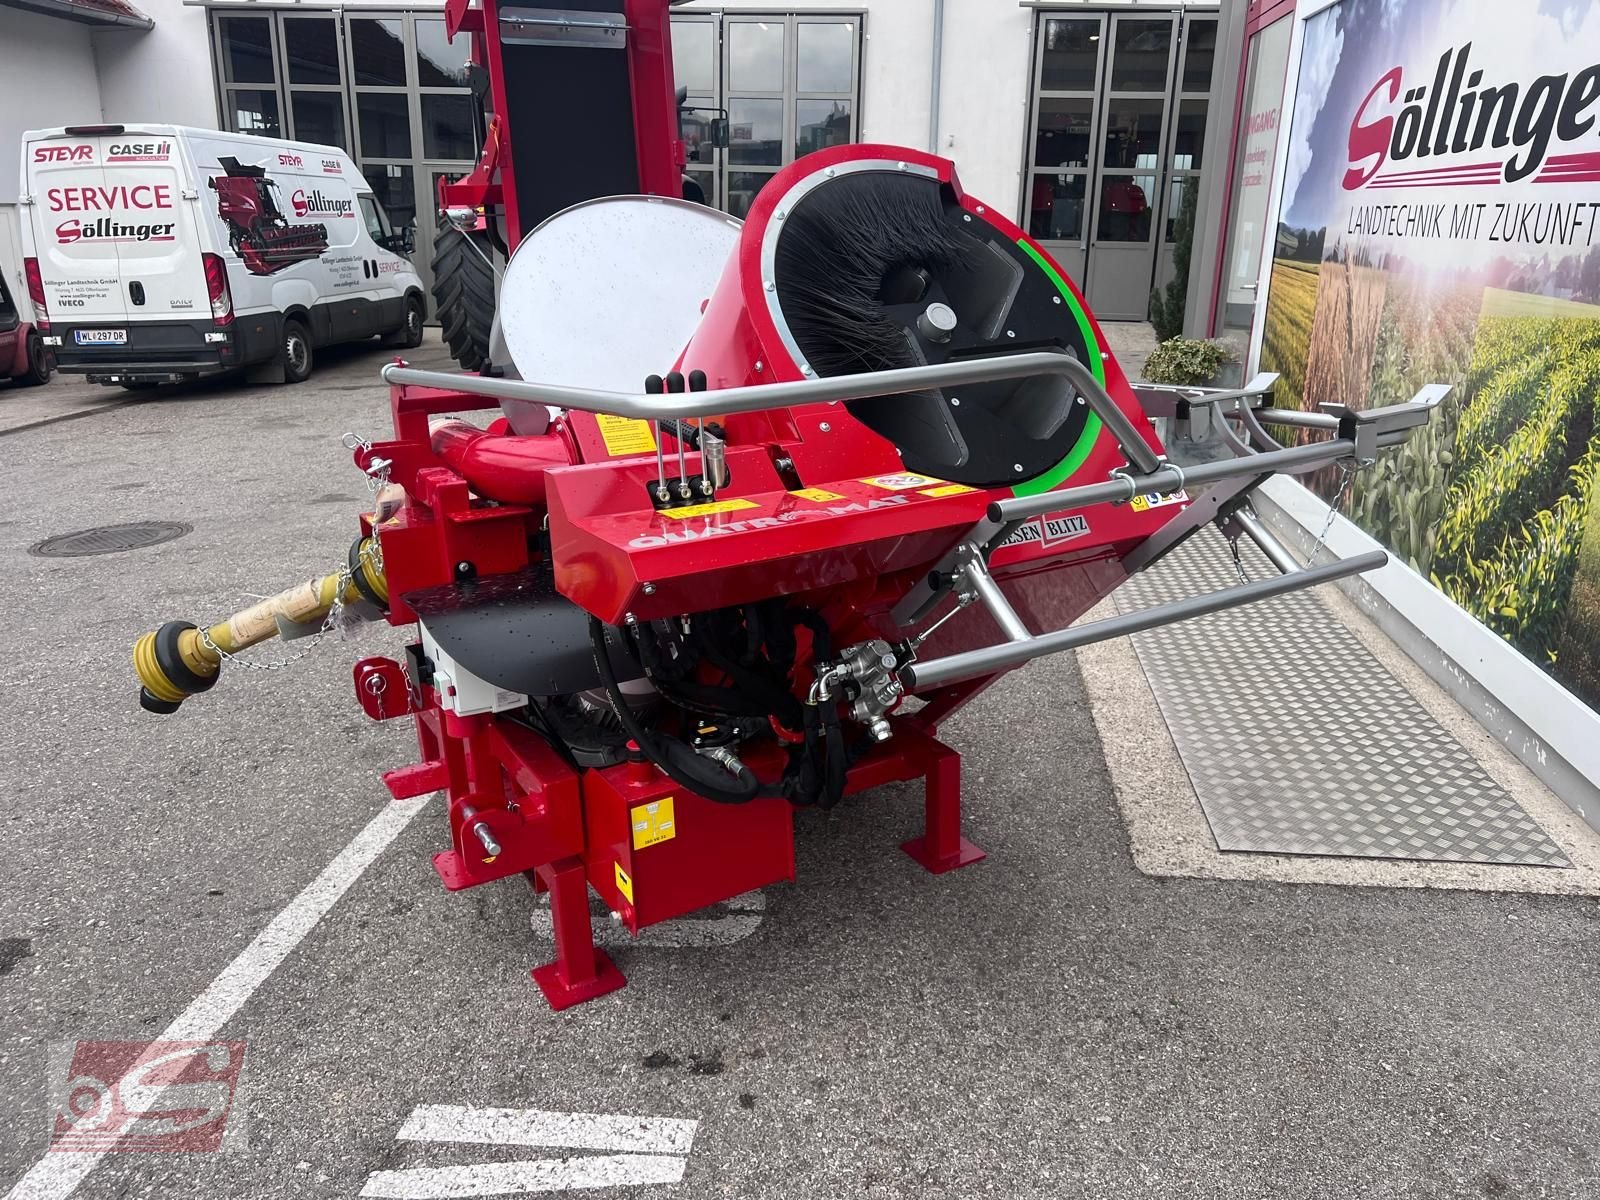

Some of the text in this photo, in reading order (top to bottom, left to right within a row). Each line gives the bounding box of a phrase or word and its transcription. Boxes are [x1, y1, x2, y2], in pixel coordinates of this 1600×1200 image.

[34, 145, 93, 162] STEYR
[109, 144, 154, 155] CASE
[278, 154, 304, 167] STEYR
[48, 185, 173, 212] SERVICE
[291, 188, 352, 218] Söllinger
[55, 218, 175, 244] Söllinger
[1348, 203, 1600, 246] LANDTECHNIK MIT ZUKUNFT
[82, 331, 124, 341] WL 297 DR
[1002, 516, 1088, 545] ESEN BLITZ
